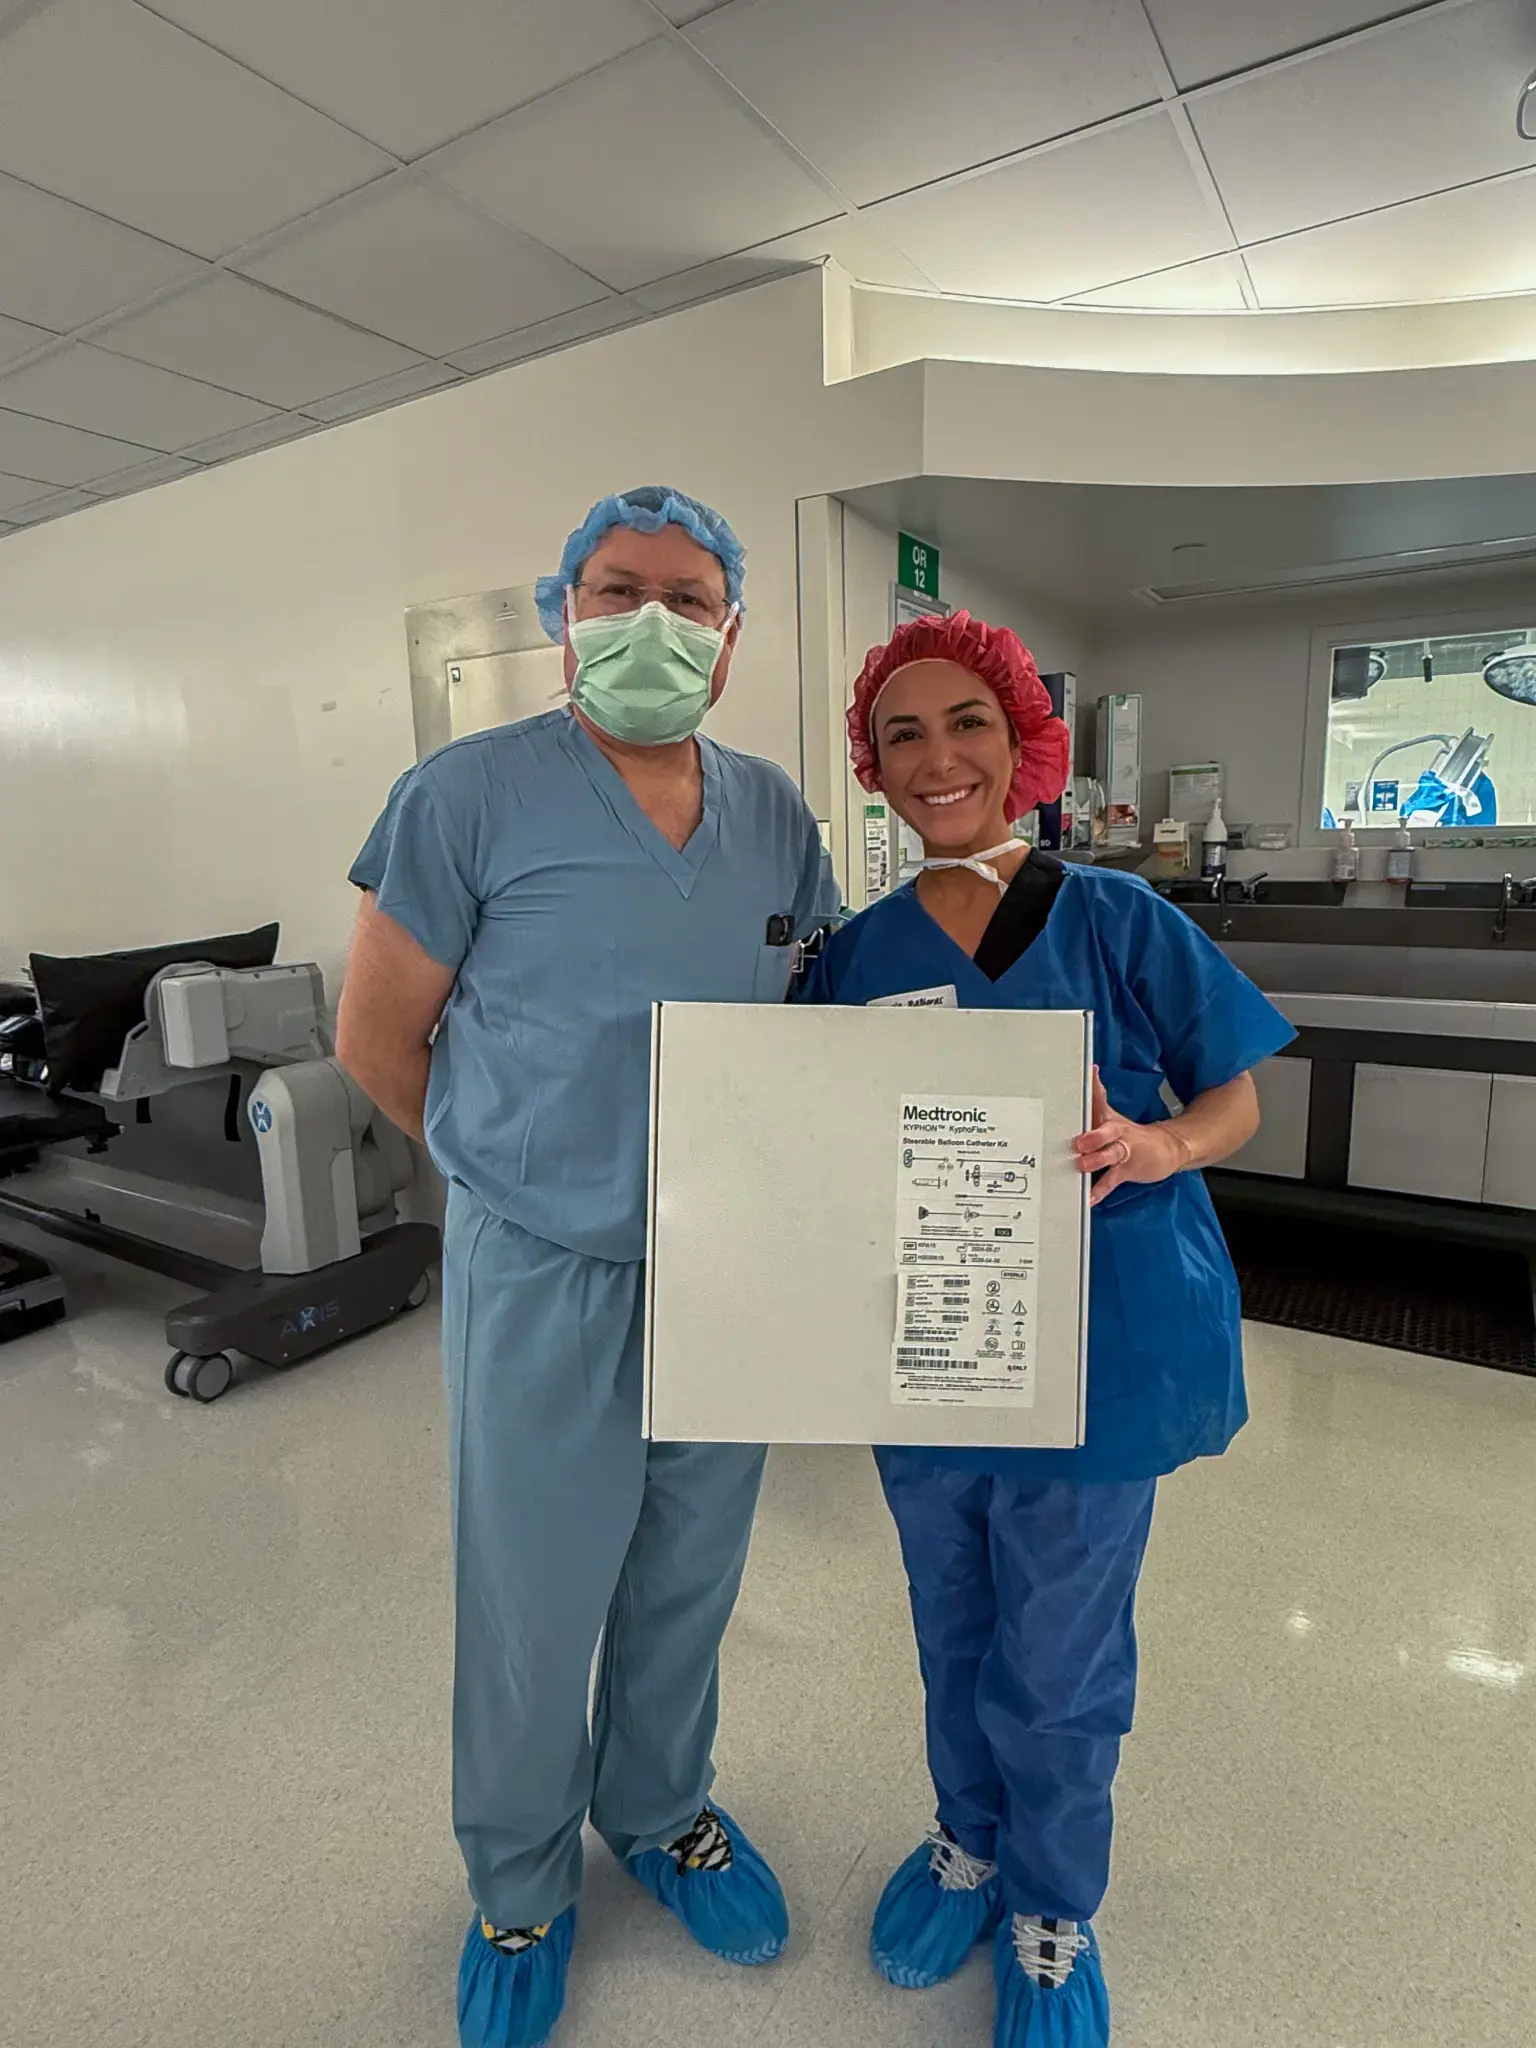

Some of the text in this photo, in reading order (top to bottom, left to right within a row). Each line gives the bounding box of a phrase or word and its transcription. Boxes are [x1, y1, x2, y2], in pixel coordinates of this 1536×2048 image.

[912, 545, 928, 569] OR
[913, 568, 926, 589] 12
[903, 1105, 987, 1123] Medtronic
[903, 1137, 1008, 1148] Steerable Balloon Catheter Kit
